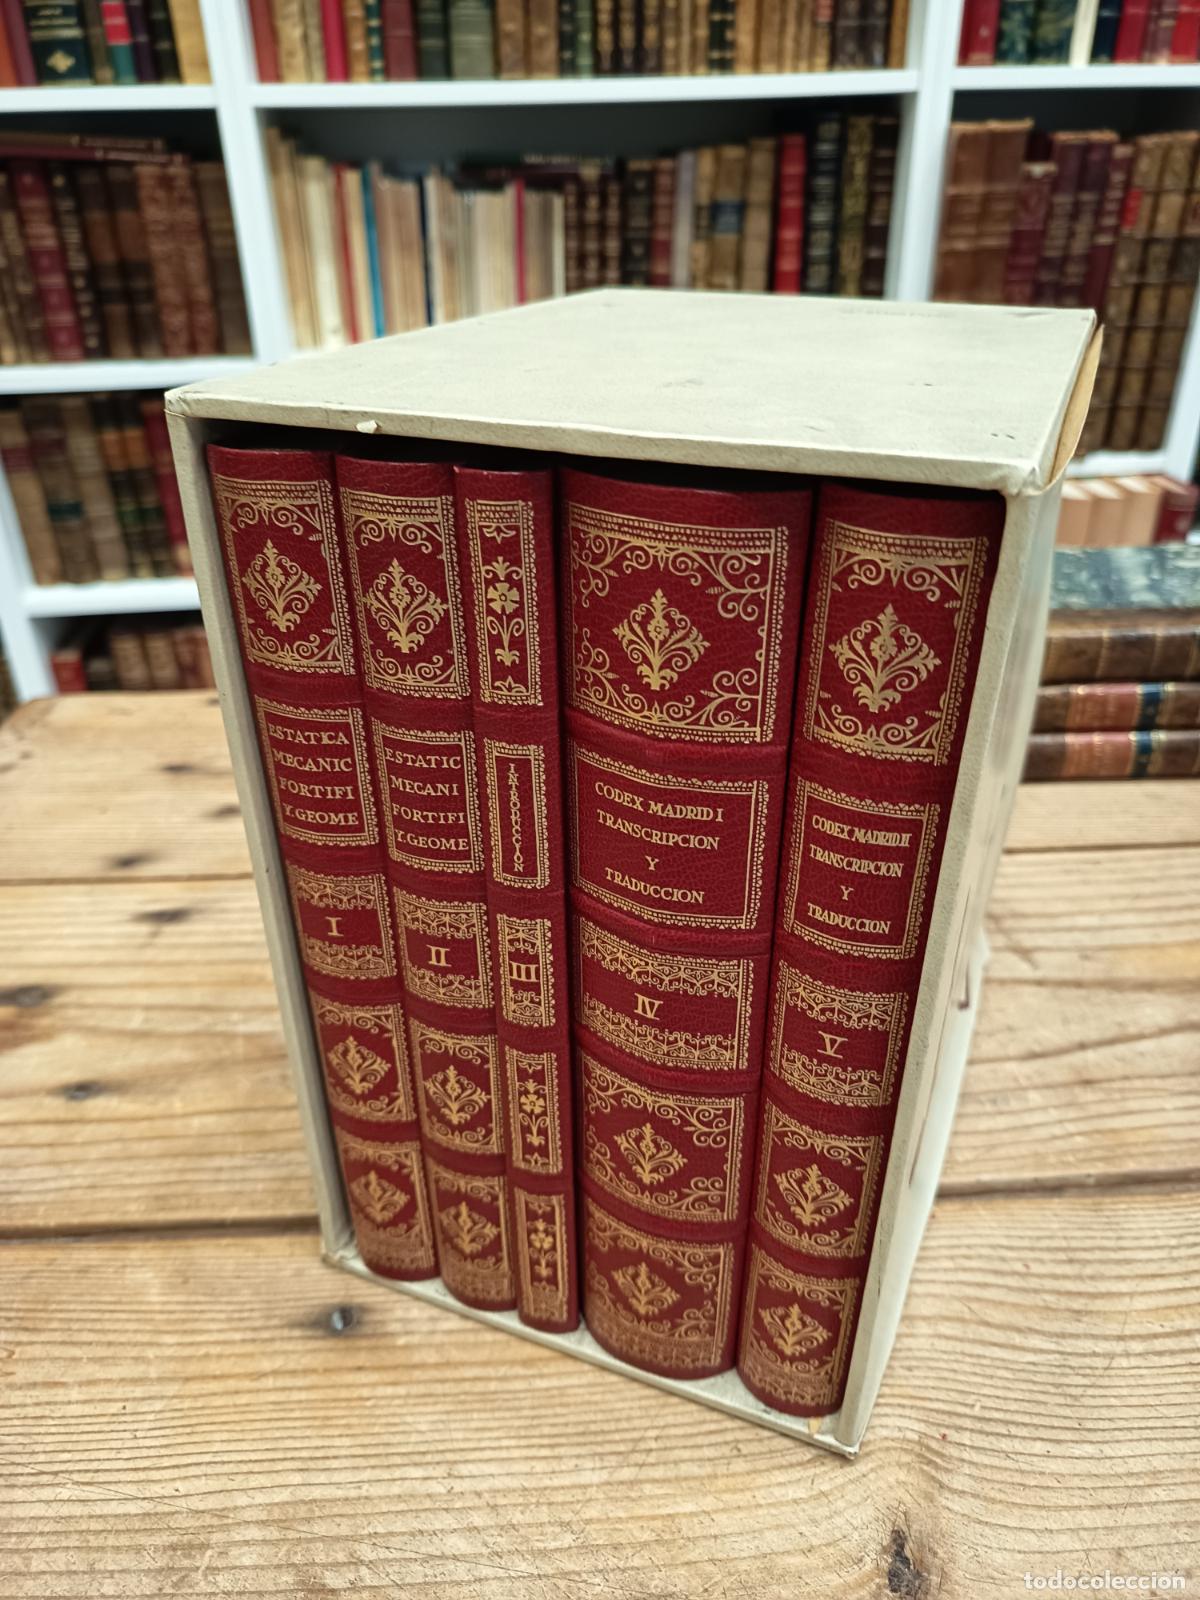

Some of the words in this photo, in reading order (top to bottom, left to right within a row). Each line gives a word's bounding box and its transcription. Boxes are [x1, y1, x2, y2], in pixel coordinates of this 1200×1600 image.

[267, 723, 350, 745] ESTATICA
[271, 748, 353, 772] MECANIC
[384, 747, 462, 769] ESTATIC
[279, 776, 355, 799] FORTIFI
[389, 775, 460, 796] MECANI
[391, 802, 466, 824] FORTIFI
[595, 782, 645, 812] CODEX
[648, 800, 714, 821] MADRID
[715, 808, 724, 822] I
[597, 809, 720, 850] TRANSCRIPCION
[812, 815, 852, 839] CODEX
[852, 827, 900, 846] MADRID
[645, 855, 660, 871] Y
[809, 843, 904, 878] TRANSCRIPCION
[605, 867, 705, 904] TRADUCCION
[840, 885, 854, 901] Y
[325, 916, 344, 937] I
[807, 902, 891, 935] TRADUCCION
[426, 945, 451, 967] II
[508, 961, 539, 982] III
[634, 993, 664, 1020] IV
[817, 1031, 849, 1058] V
